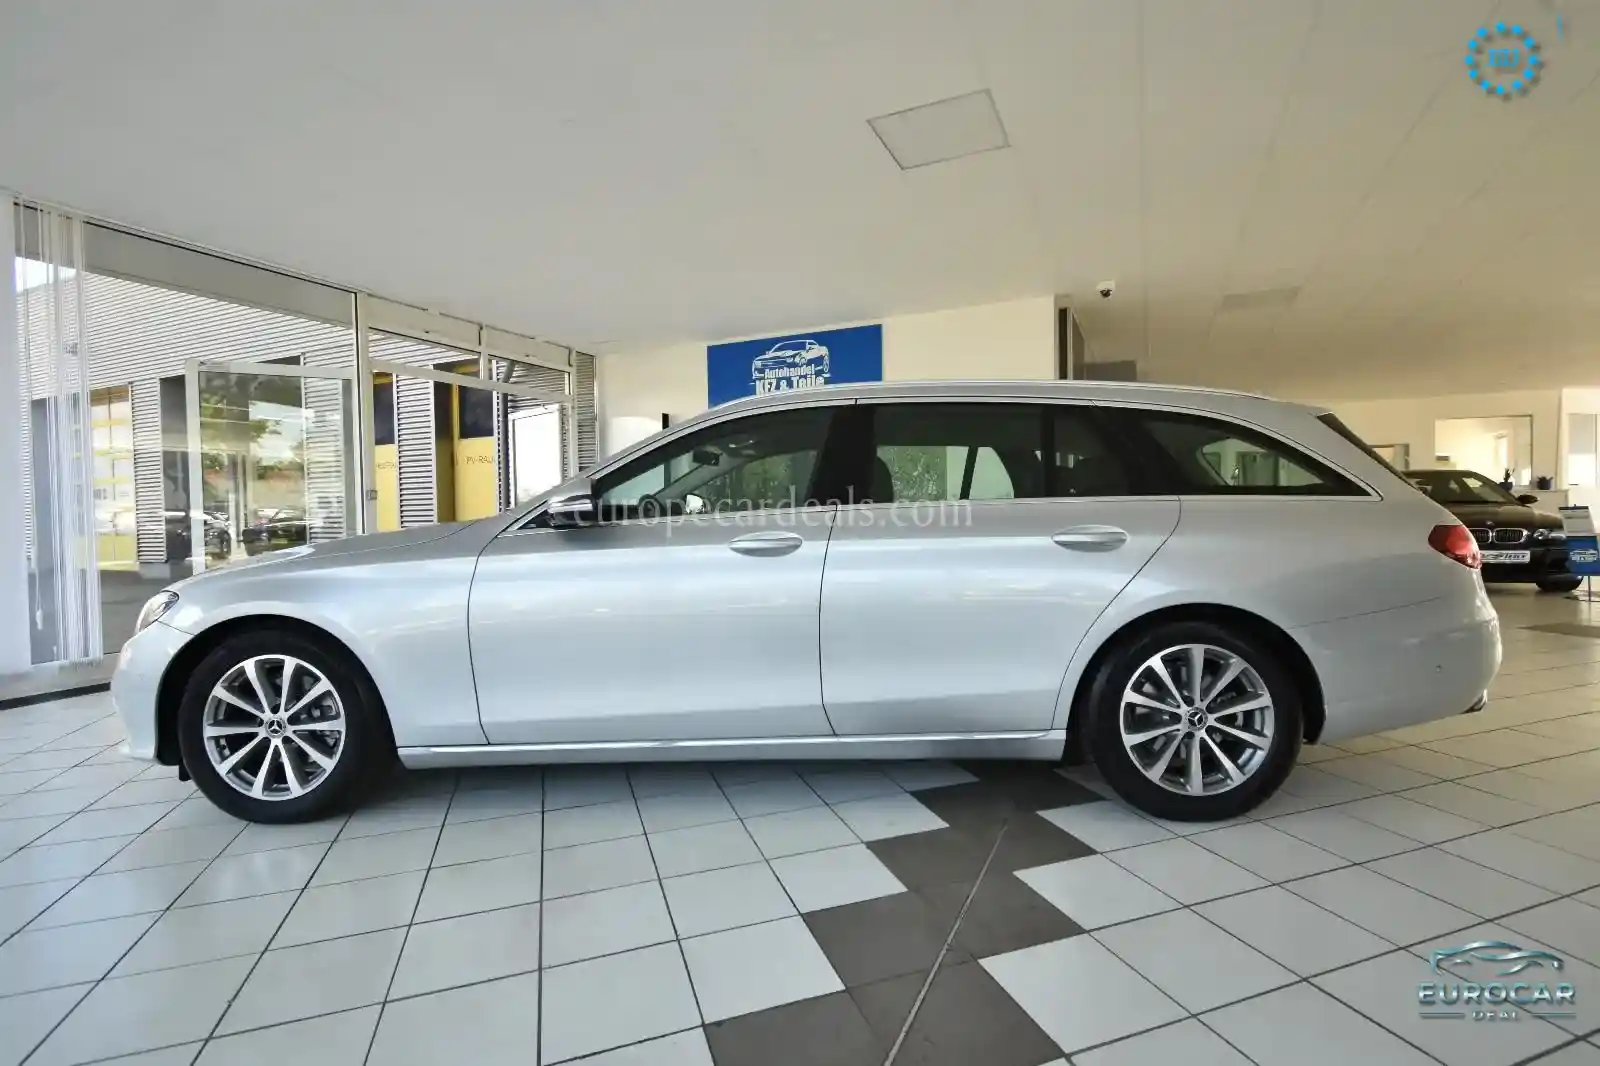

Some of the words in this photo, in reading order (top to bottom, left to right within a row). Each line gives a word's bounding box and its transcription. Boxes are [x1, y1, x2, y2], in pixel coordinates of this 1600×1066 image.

[764, 364, 815, 379] Autohandel
[756, 378, 777, 395] KFZ
[791, 374, 825, 390] Teile
